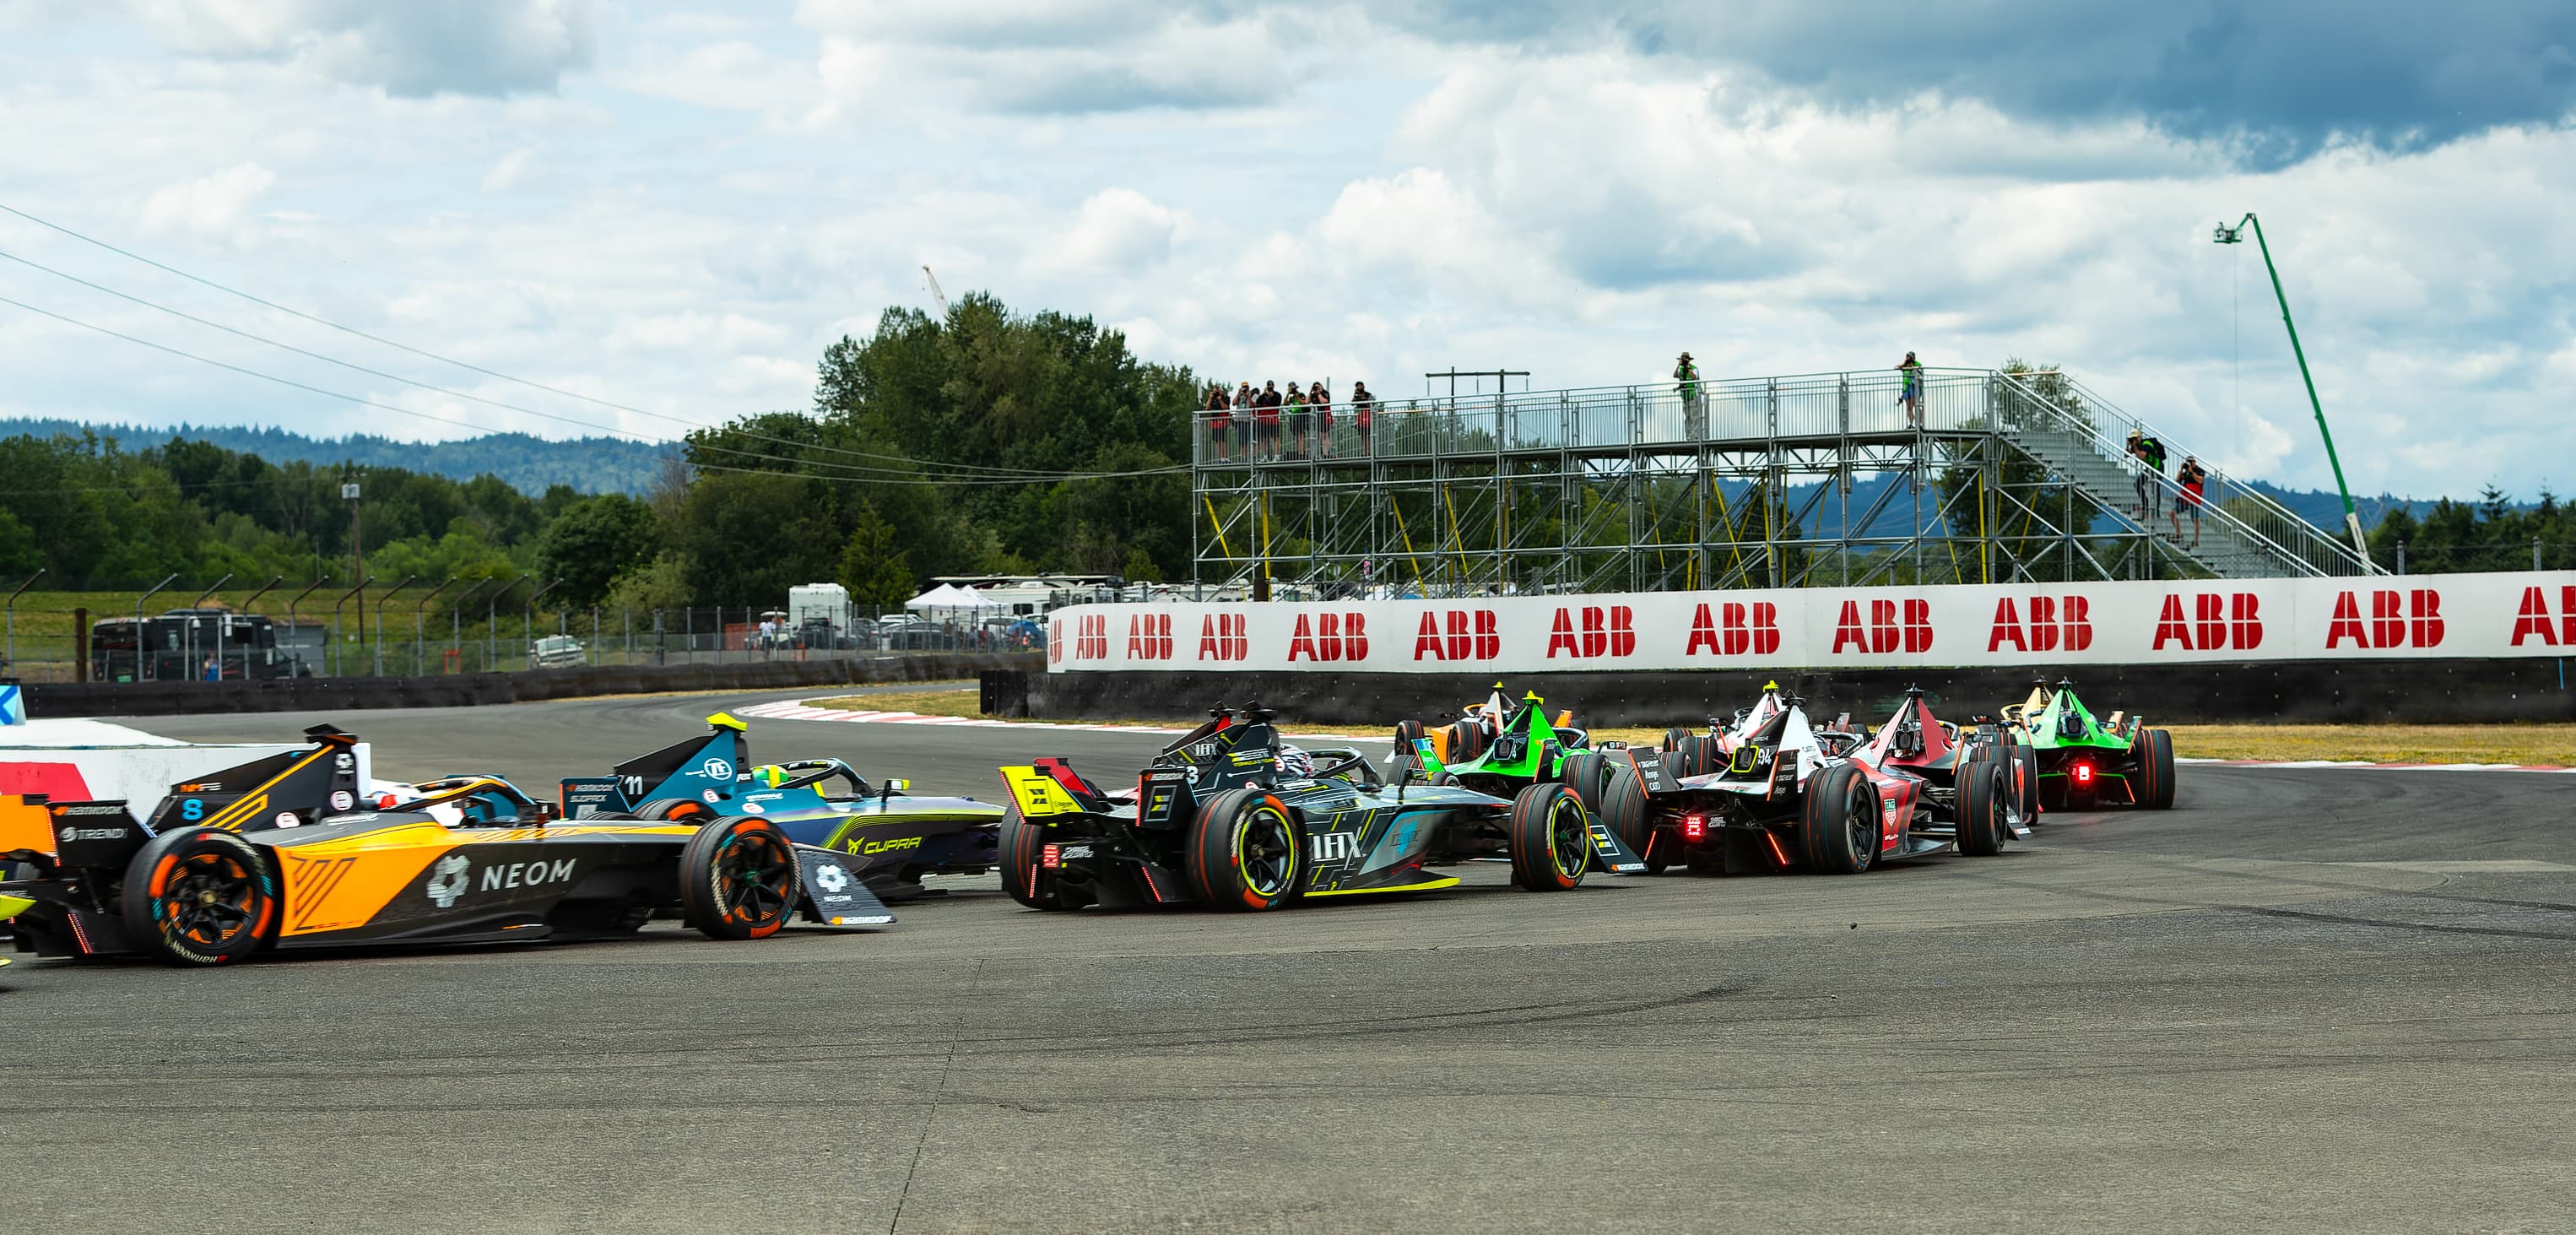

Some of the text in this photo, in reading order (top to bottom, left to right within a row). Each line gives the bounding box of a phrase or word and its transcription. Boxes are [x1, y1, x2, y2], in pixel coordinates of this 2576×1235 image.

[1076, 615, 1107, 659] ABB
[1128, 614, 1173, 660] ABB
[1199, 614, 1247, 661] ABB
[1288, 613, 1368, 662] ABB
[1414, 610, 1500, 661] ABB
[1547, 606, 1636, 658] ABB
[1686, 603, 1781, 656] ABB
[1832, 599, 1934, 654] ABB
[1988, 596, 2093, 653] ABB
[2152, 593, 2264, 651] ABB
[2326, 590, 2445, 649] ABB
[1187, 766, 1199, 784] 3
[1758, 749, 1772, 765] 94
[625, 776, 642, 794] 11
[181, 799, 203, 820] 8
[77, 829, 125, 840] TREND
[864, 837, 923, 855] CUPRA
[480, 858, 577, 891] NEOM
